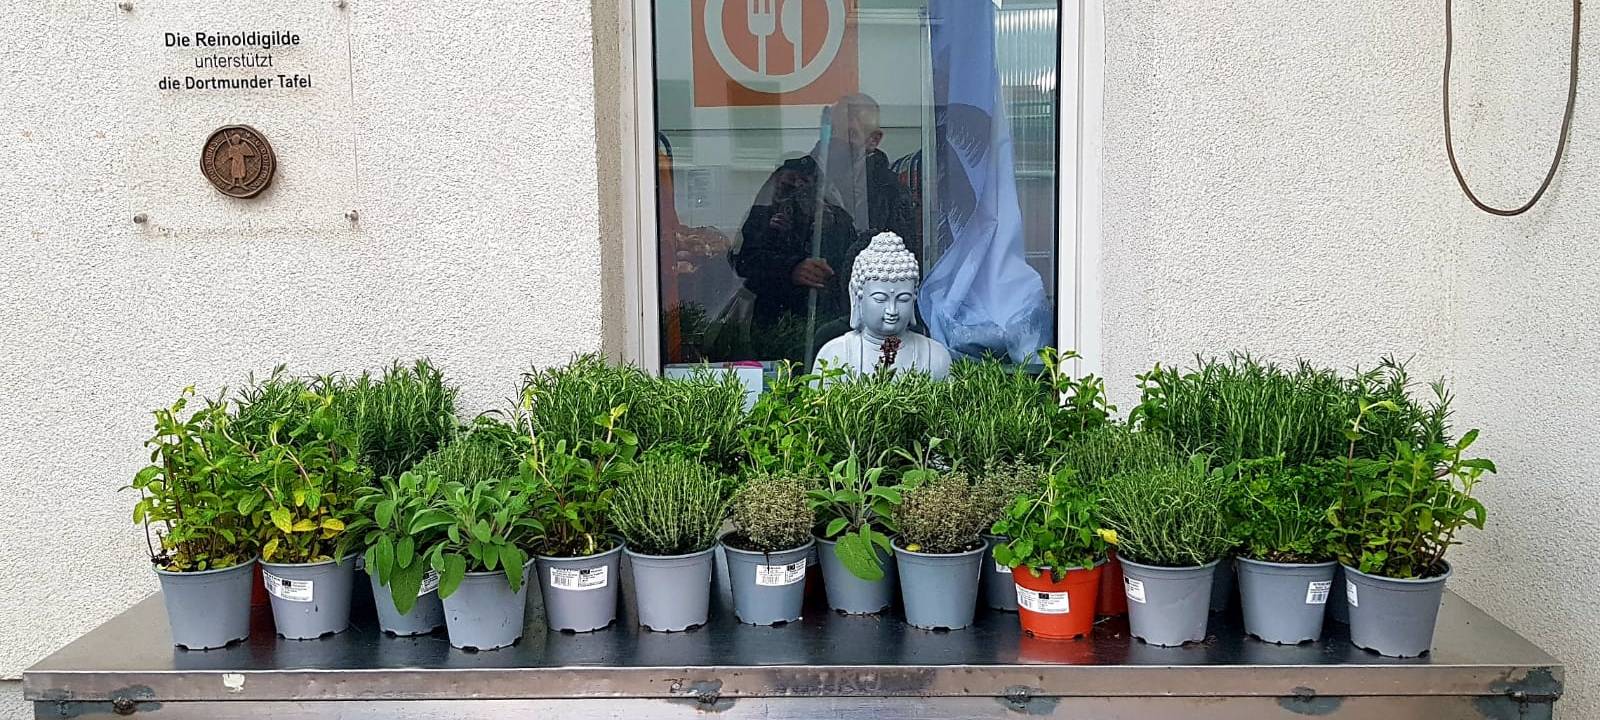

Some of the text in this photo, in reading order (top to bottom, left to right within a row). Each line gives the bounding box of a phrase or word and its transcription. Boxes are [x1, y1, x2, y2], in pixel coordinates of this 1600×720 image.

[165, 31, 300, 49] Die Reinoldigilde
[195, 53, 273, 68] unterstützt
[158, 74, 312, 90] die Dortmunder Tafel
